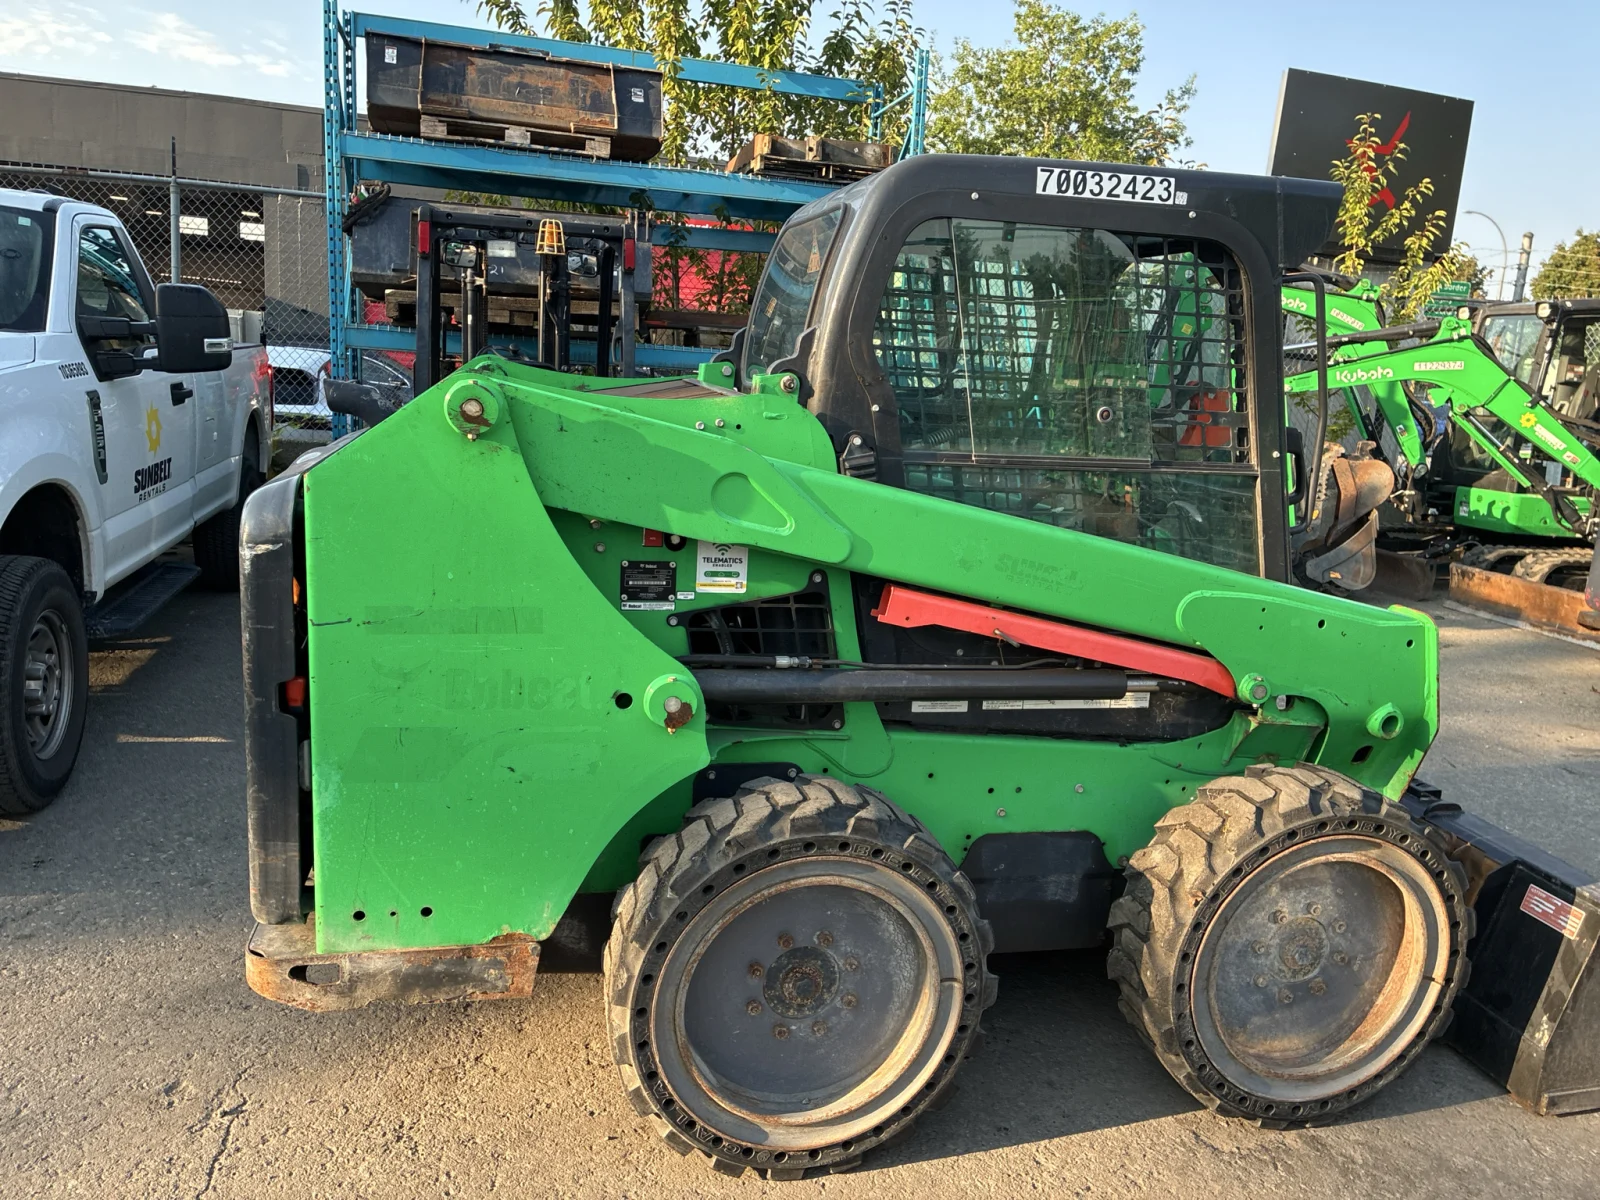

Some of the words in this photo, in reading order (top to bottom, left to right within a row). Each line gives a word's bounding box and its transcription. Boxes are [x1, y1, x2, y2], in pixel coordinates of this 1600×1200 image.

[1039, 168, 1173, 203] 70032423
[1281, 293, 1308, 311] bota
[1336, 365, 1394, 383] Kubota
[134, 457, 172, 494] SUNBELT
[138, 483, 166, 502] RENTALS
[702, 557, 743, 565] TELEMATICS
[1300, 820, 1400, 841] BABY
